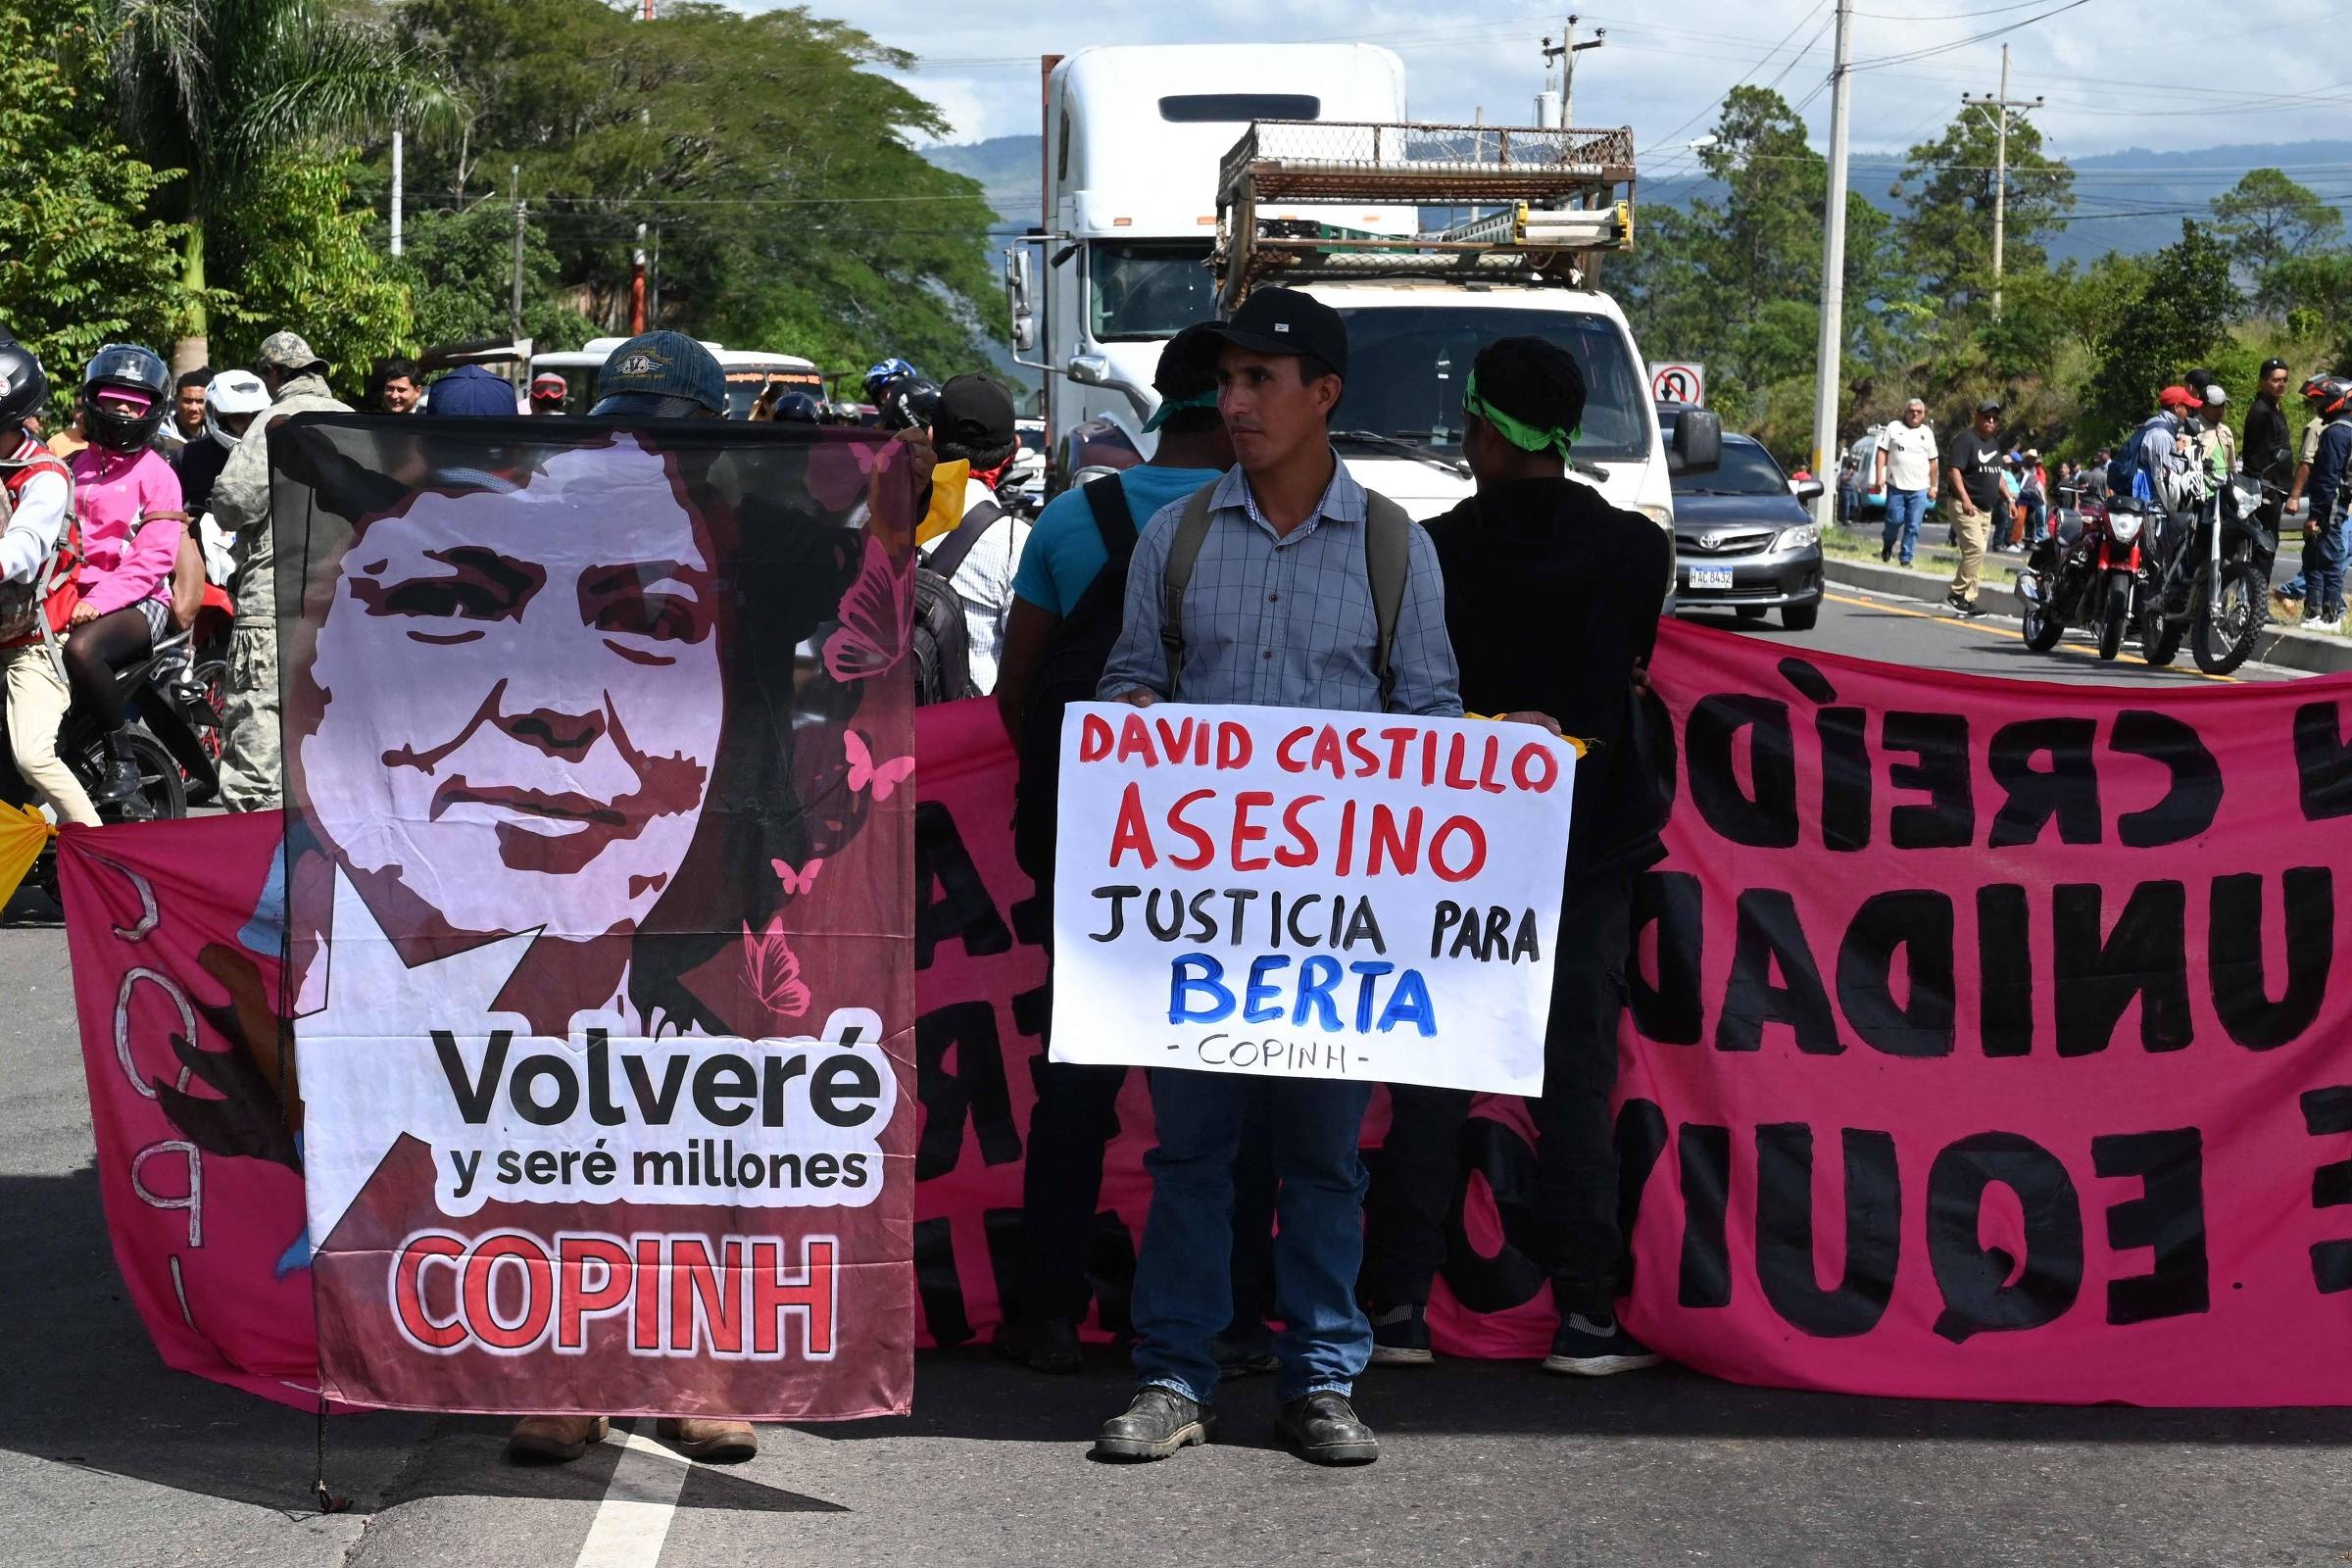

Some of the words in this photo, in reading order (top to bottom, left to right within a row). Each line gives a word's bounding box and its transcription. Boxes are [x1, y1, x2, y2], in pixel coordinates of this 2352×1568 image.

[1079, 711, 1253, 770] DAVID
[1276, 723, 1559, 794] CASTILLO
[1108, 781, 1488, 882] ASESINO
[1088, 885, 1387, 955] JUSTICIA
[1430, 899, 1541, 965] PARA
[1167, 952, 1439, 1038] BERTA
[429, 1026, 881, 1128] Volveré
[450, 1149, 481, 1199] y
[496, 1139, 616, 1187] seré
[632, 1139, 868, 1189] millones
[394, 1233, 835, 1355] COPINH
